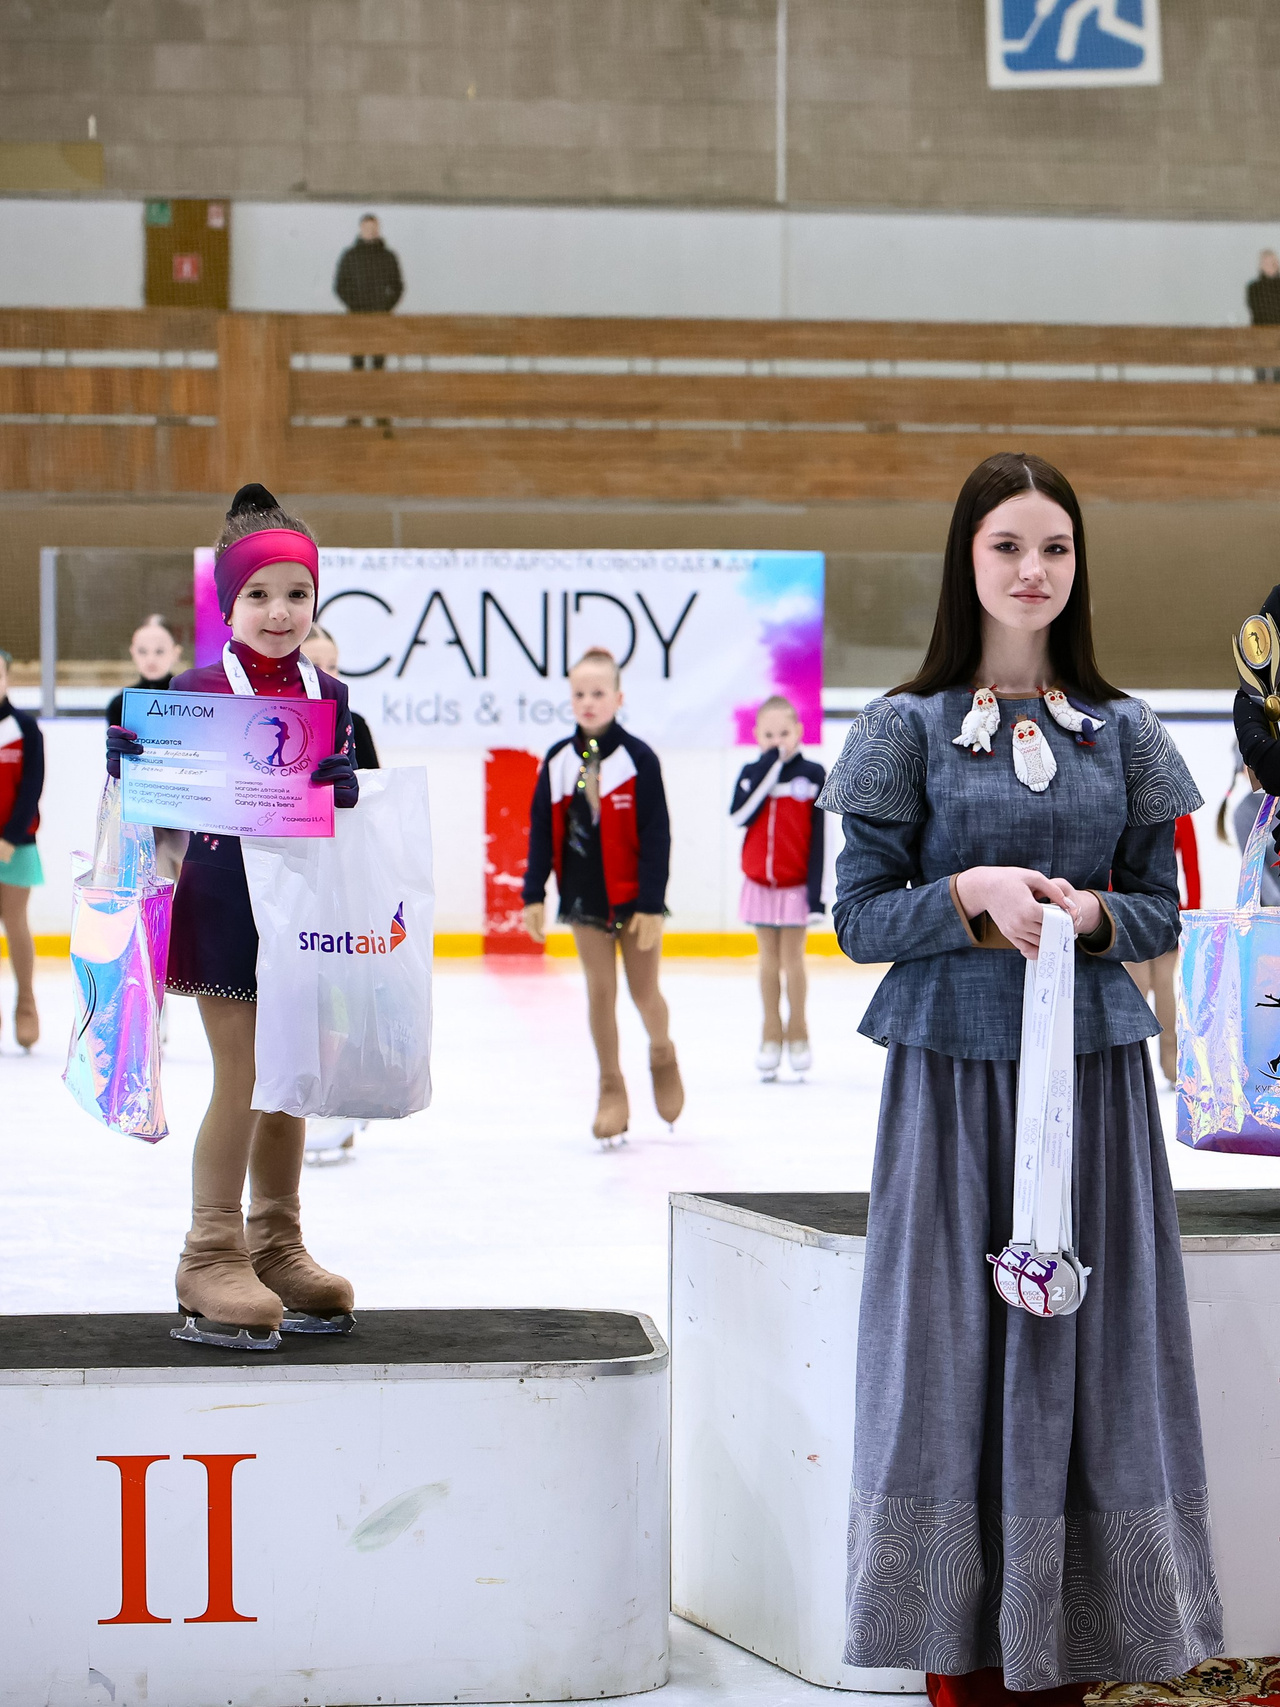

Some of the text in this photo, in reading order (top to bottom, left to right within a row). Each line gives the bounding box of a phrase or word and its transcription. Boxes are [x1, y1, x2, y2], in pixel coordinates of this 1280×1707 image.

[314, 589, 698, 679] CANDY
[382, 693, 460, 725] kids
[474, 693, 501, 725] &
[132, 738, 182, 746] аграждается
[243, 752, 312, 776] КУБОК CANDY
[135, 782, 190, 792] соревнованиях
[139, 790, 180, 800] фигурному
[235, 800, 257, 808] Candy
[1052, 1287, 1062, 1301] 2
[96, 1453, 258, 1625] II
